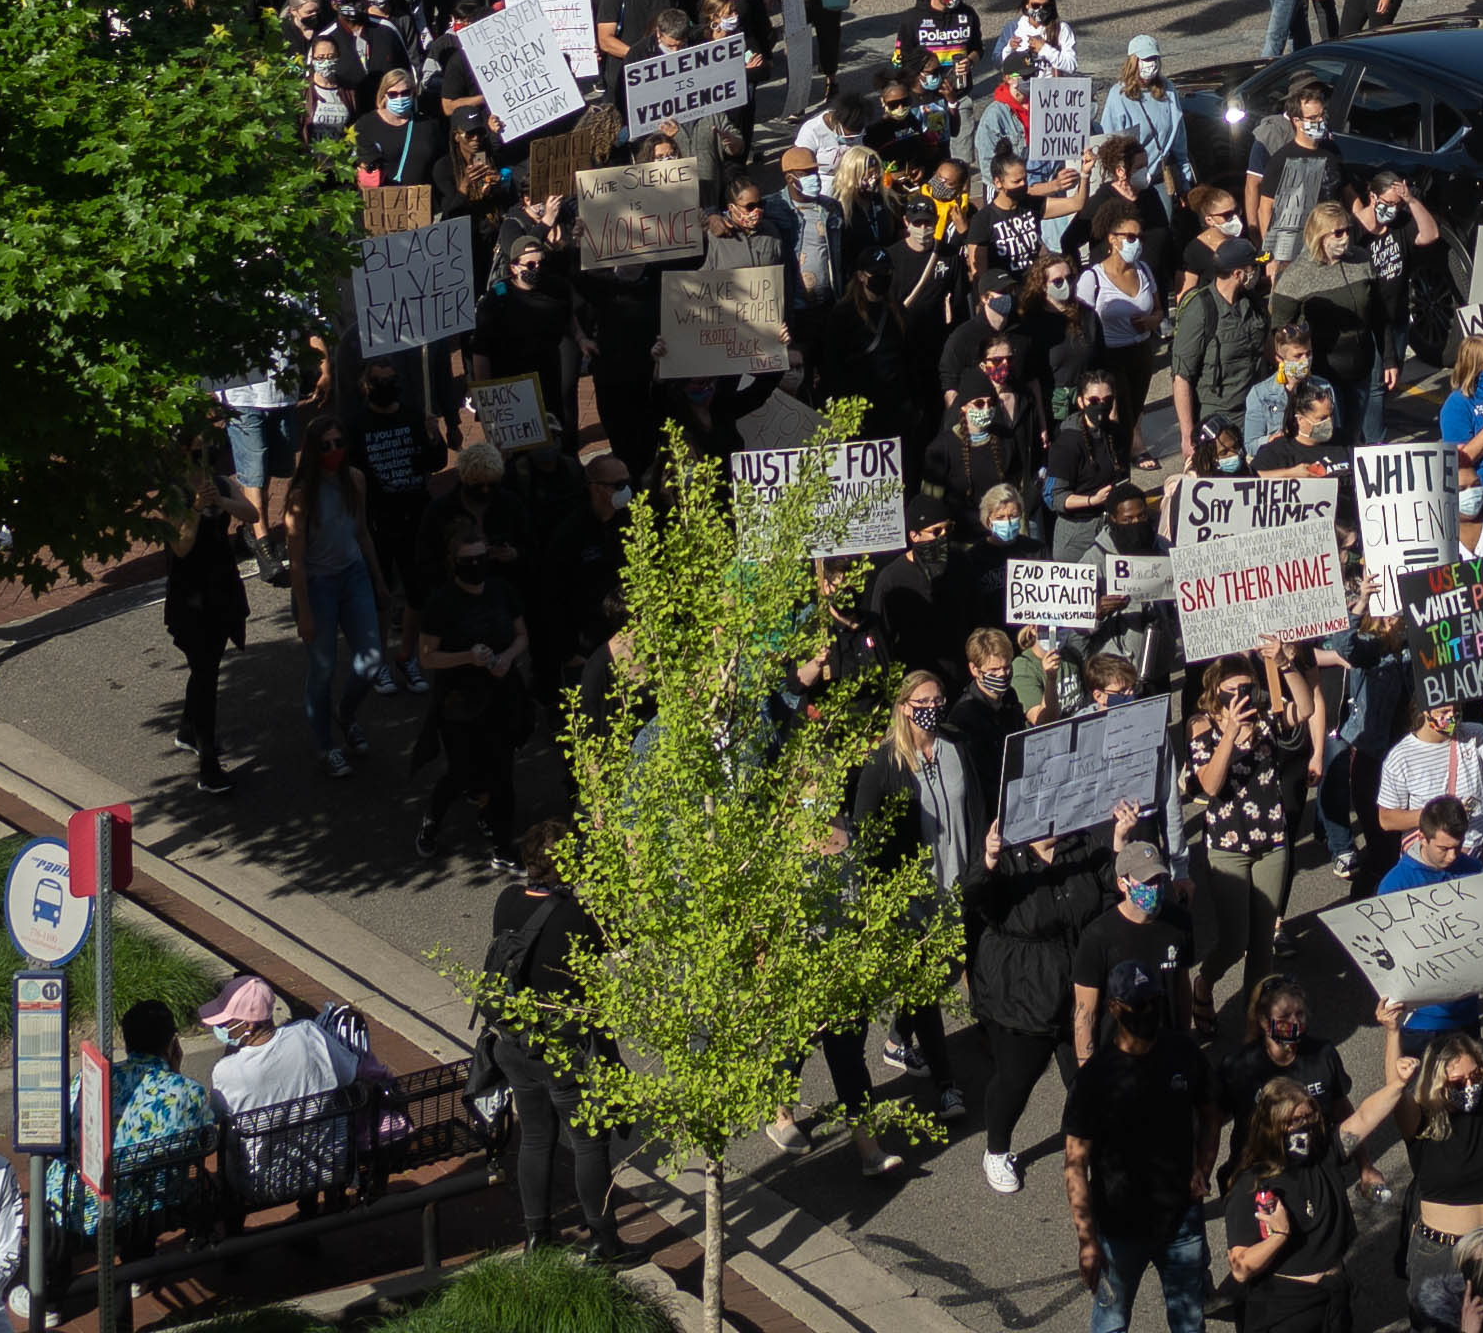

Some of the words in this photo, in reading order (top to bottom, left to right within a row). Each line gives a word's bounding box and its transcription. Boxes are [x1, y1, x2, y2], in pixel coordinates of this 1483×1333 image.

[493, 0, 545, 34] SYSTEM
[918, 26, 971, 43] Polaroid
[627, 39, 744, 86] SILENCE
[502, 73, 554, 108] BUILT
[674, 77, 695, 92] IS
[636, 80, 737, 125] VIOLENCE
[1038, 88, 1059, 108] We
[1066, 90, 1086, 108] are
[507, 105, 545, 133] THIS
[1044, 112, 1081, 133] DONE
[1041, 136, 1086, 157] DYING!
[366, 187, 431, 211] BLACK
[369, 211, 418, 231] LIVES
[360, 223, 462, 275] BLACK
[366, 254, 466, 307] LIVES
[681, 281, 733, 302] WAKE
[750, 279, 771, 299] UP
[366, 286, 474, 348] MATTER
[673, 301, 726, 326] WHITE
[726, 341, 764, 357] BLACK
[749, 354, 784, 370] LIVES
[477, 384, 521, 407] BLACK
[484, 407, 514, 425] LIVES
[846, 440, 900, 479] FOR
[1356, 449, 1457, 499] WHITE
[1188, 480, 1234, 529] SAY
[1234, 479, 1301, 506] THEIR
[1013, 564, 1044, 581] END
[1050, 566, 1095, 582] POLICE
[1179, 576, 1217, 613] SAY
[1219, 564, 1274, 606] THEIR
[1275, 552, 1334, 596] NAME
[1428, 566, 1462, 593] USE
[1010, 582, 1097, 608] BRUTALITY
[1409, 586, 1472, 627] WHITE
[1324, 616, 1349, 632] MORE
[1425, 622, 1451, 642] TO
[1419, 635, 1474, 670] WHITE
[1355, 878, 1477, 933] BLACK
[1409, 910, 1481, 951] LIVES
[45, 985, 58, 998] 11
